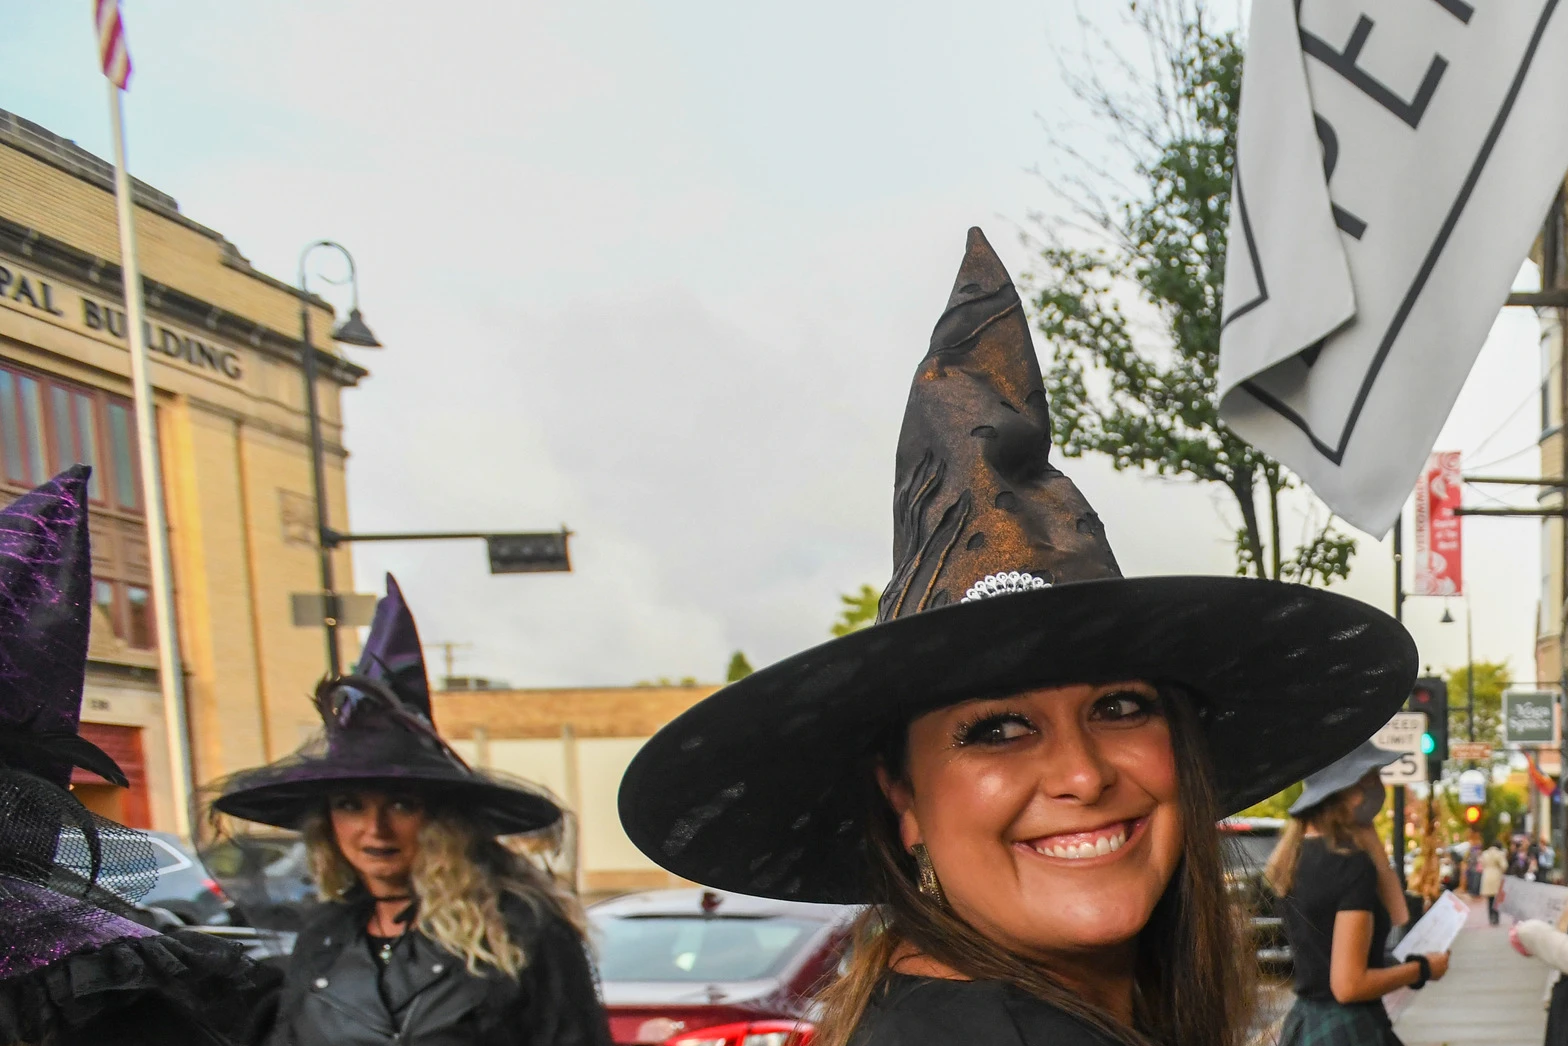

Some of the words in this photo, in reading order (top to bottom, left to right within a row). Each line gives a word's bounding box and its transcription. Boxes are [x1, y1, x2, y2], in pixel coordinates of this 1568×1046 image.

[83, 297, 242, 380] BULDING
[1378, 733, 1414, 745] LIMIT
[1380, 752, 1417, 776] 5
